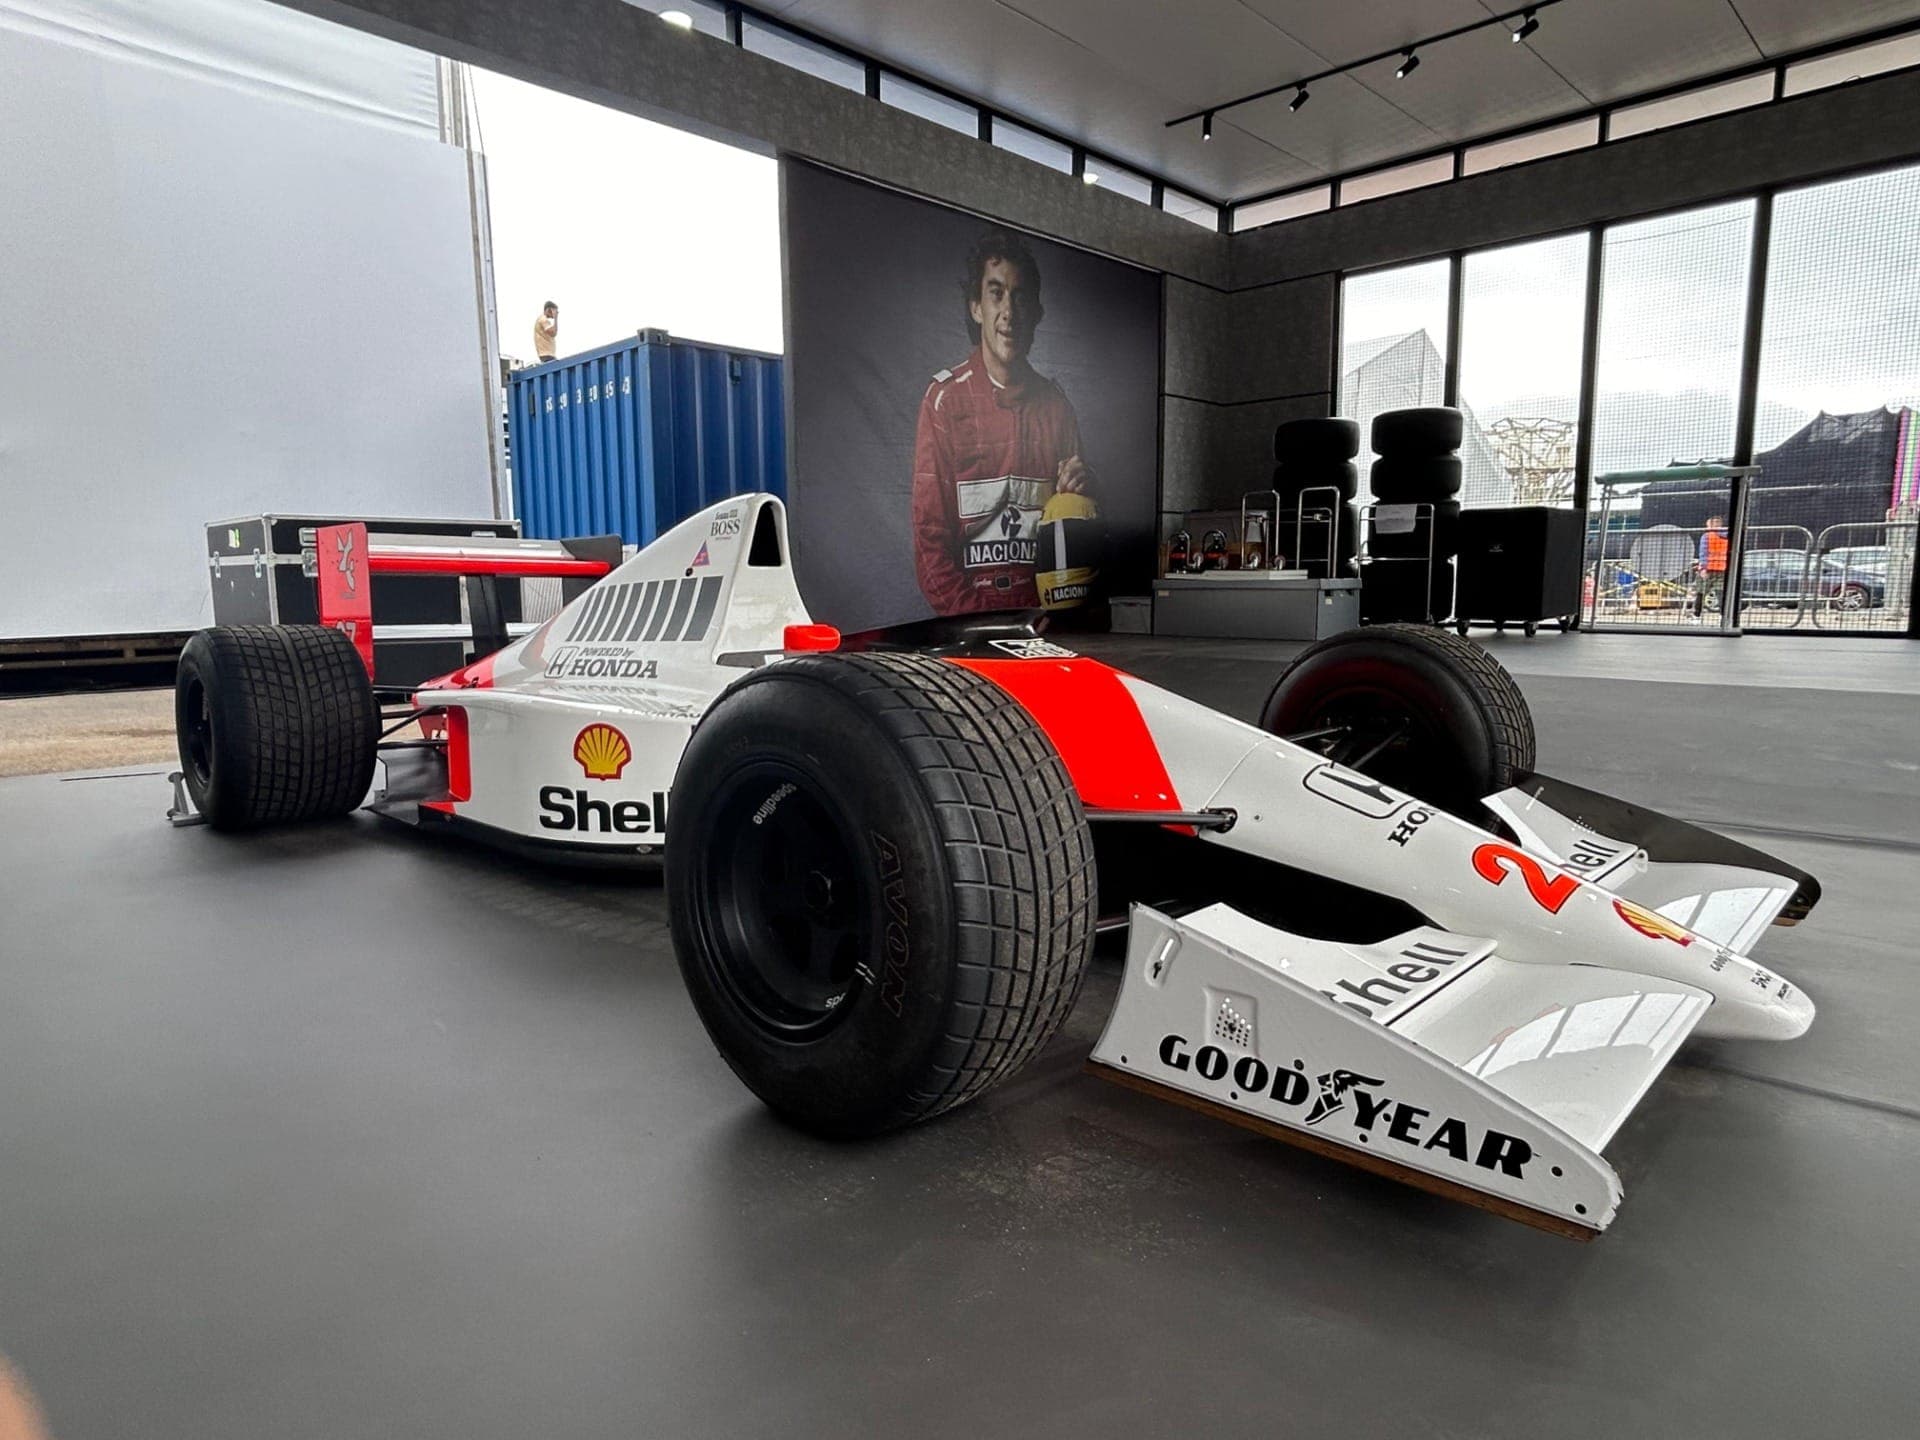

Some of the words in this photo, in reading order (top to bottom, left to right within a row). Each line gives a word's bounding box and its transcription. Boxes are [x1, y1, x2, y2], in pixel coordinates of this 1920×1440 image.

[711, 519, 740, 536] BOSS
[578, 647, 624, 657] POWERED
[568, 658, 658, 679] HONDA
[540, 785, 671, 834] Shel
[870, 831, 910, 1018] AVON
